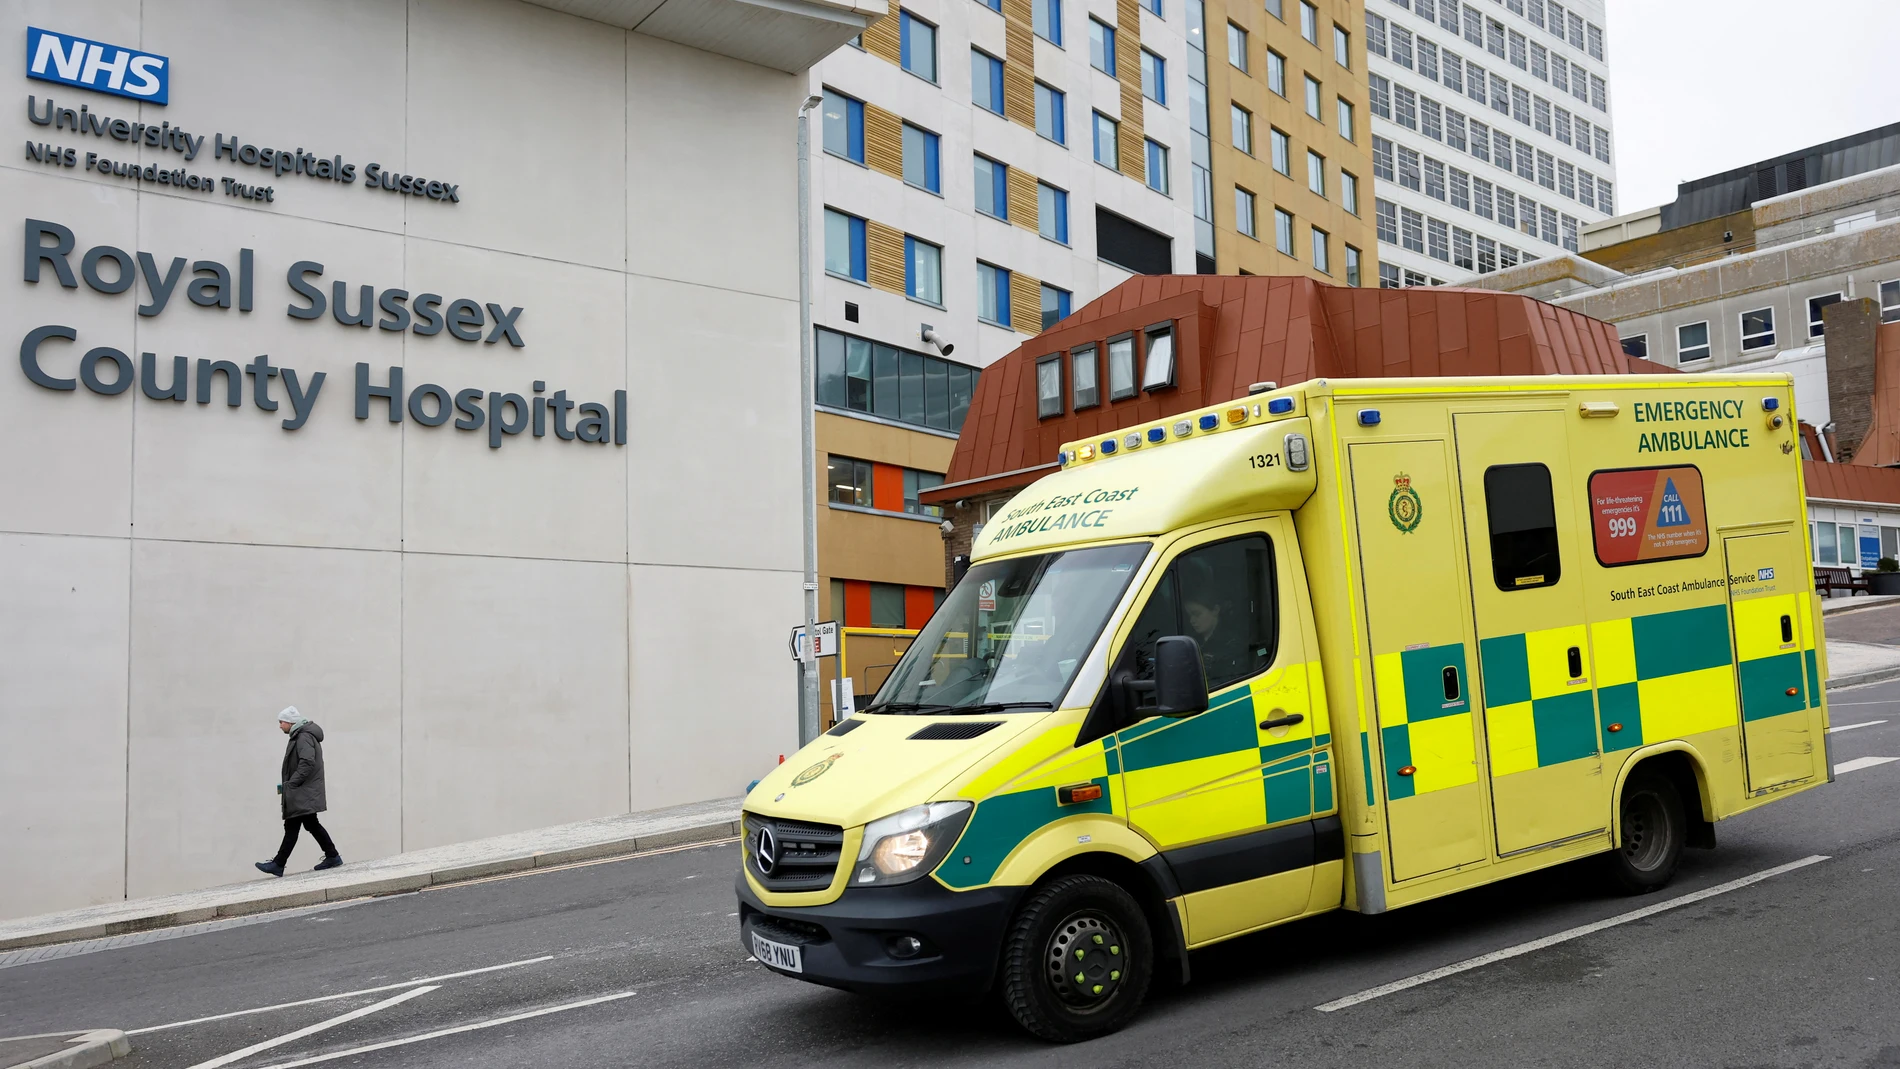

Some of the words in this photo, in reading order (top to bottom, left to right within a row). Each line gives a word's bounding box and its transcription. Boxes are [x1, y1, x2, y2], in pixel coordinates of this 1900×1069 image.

[31, 34, 163, 96] NHS
[28, 95, 204, 160] University
[215, 133, 356, 184] Hospitals
[365, 163, 459, 202] Sussex
[26, 141, 77, 168] NHS
[86, 152, 214, 193] Foundation
[222, 177, 274, 202] Trust
[24, 218, 254, 317] Royal
[287, 260, 525, 348] Sussex
[20, 325, 326, 430] County
[355, 362, 627, 448] Hospital
[1634, 400, 1743, 422] EMERGENCY
[1638, 428, 1749, 453] AMBULANCE
[1248, 453, 1282, 469] 1321
[1002, 500, 1044, 523] South
[1044, 492, 1082, 510] East
[1083, 487, 1139, 504] Coast
[1606, 495, 1643, 505] life-threatening
[1663, 494, 1680, 502] CALL
[1602, 506, 1632, 515] emergencies
[1662, 505, 1682, 523] 111
[989, 510, 1113, 545] AMBULANCE
[1609, 517, 1637, 538] 999
[1675, 538, 1698, 546] emergency
[1758, 569, 1774, 580] NHS
[1610, 588, 1636, 601] South
[1638, 585, 1655, 598] East
[1657, 583, 1680, 595] Coast
[1682, 578, 1725, 592] Ambulance
[1729, 573, 1756, 586] Service
[1741, 586, 1764, 595] Foundation
[822, 626, 833, 635] Gate
[773, 945, 796, 968] YNU
